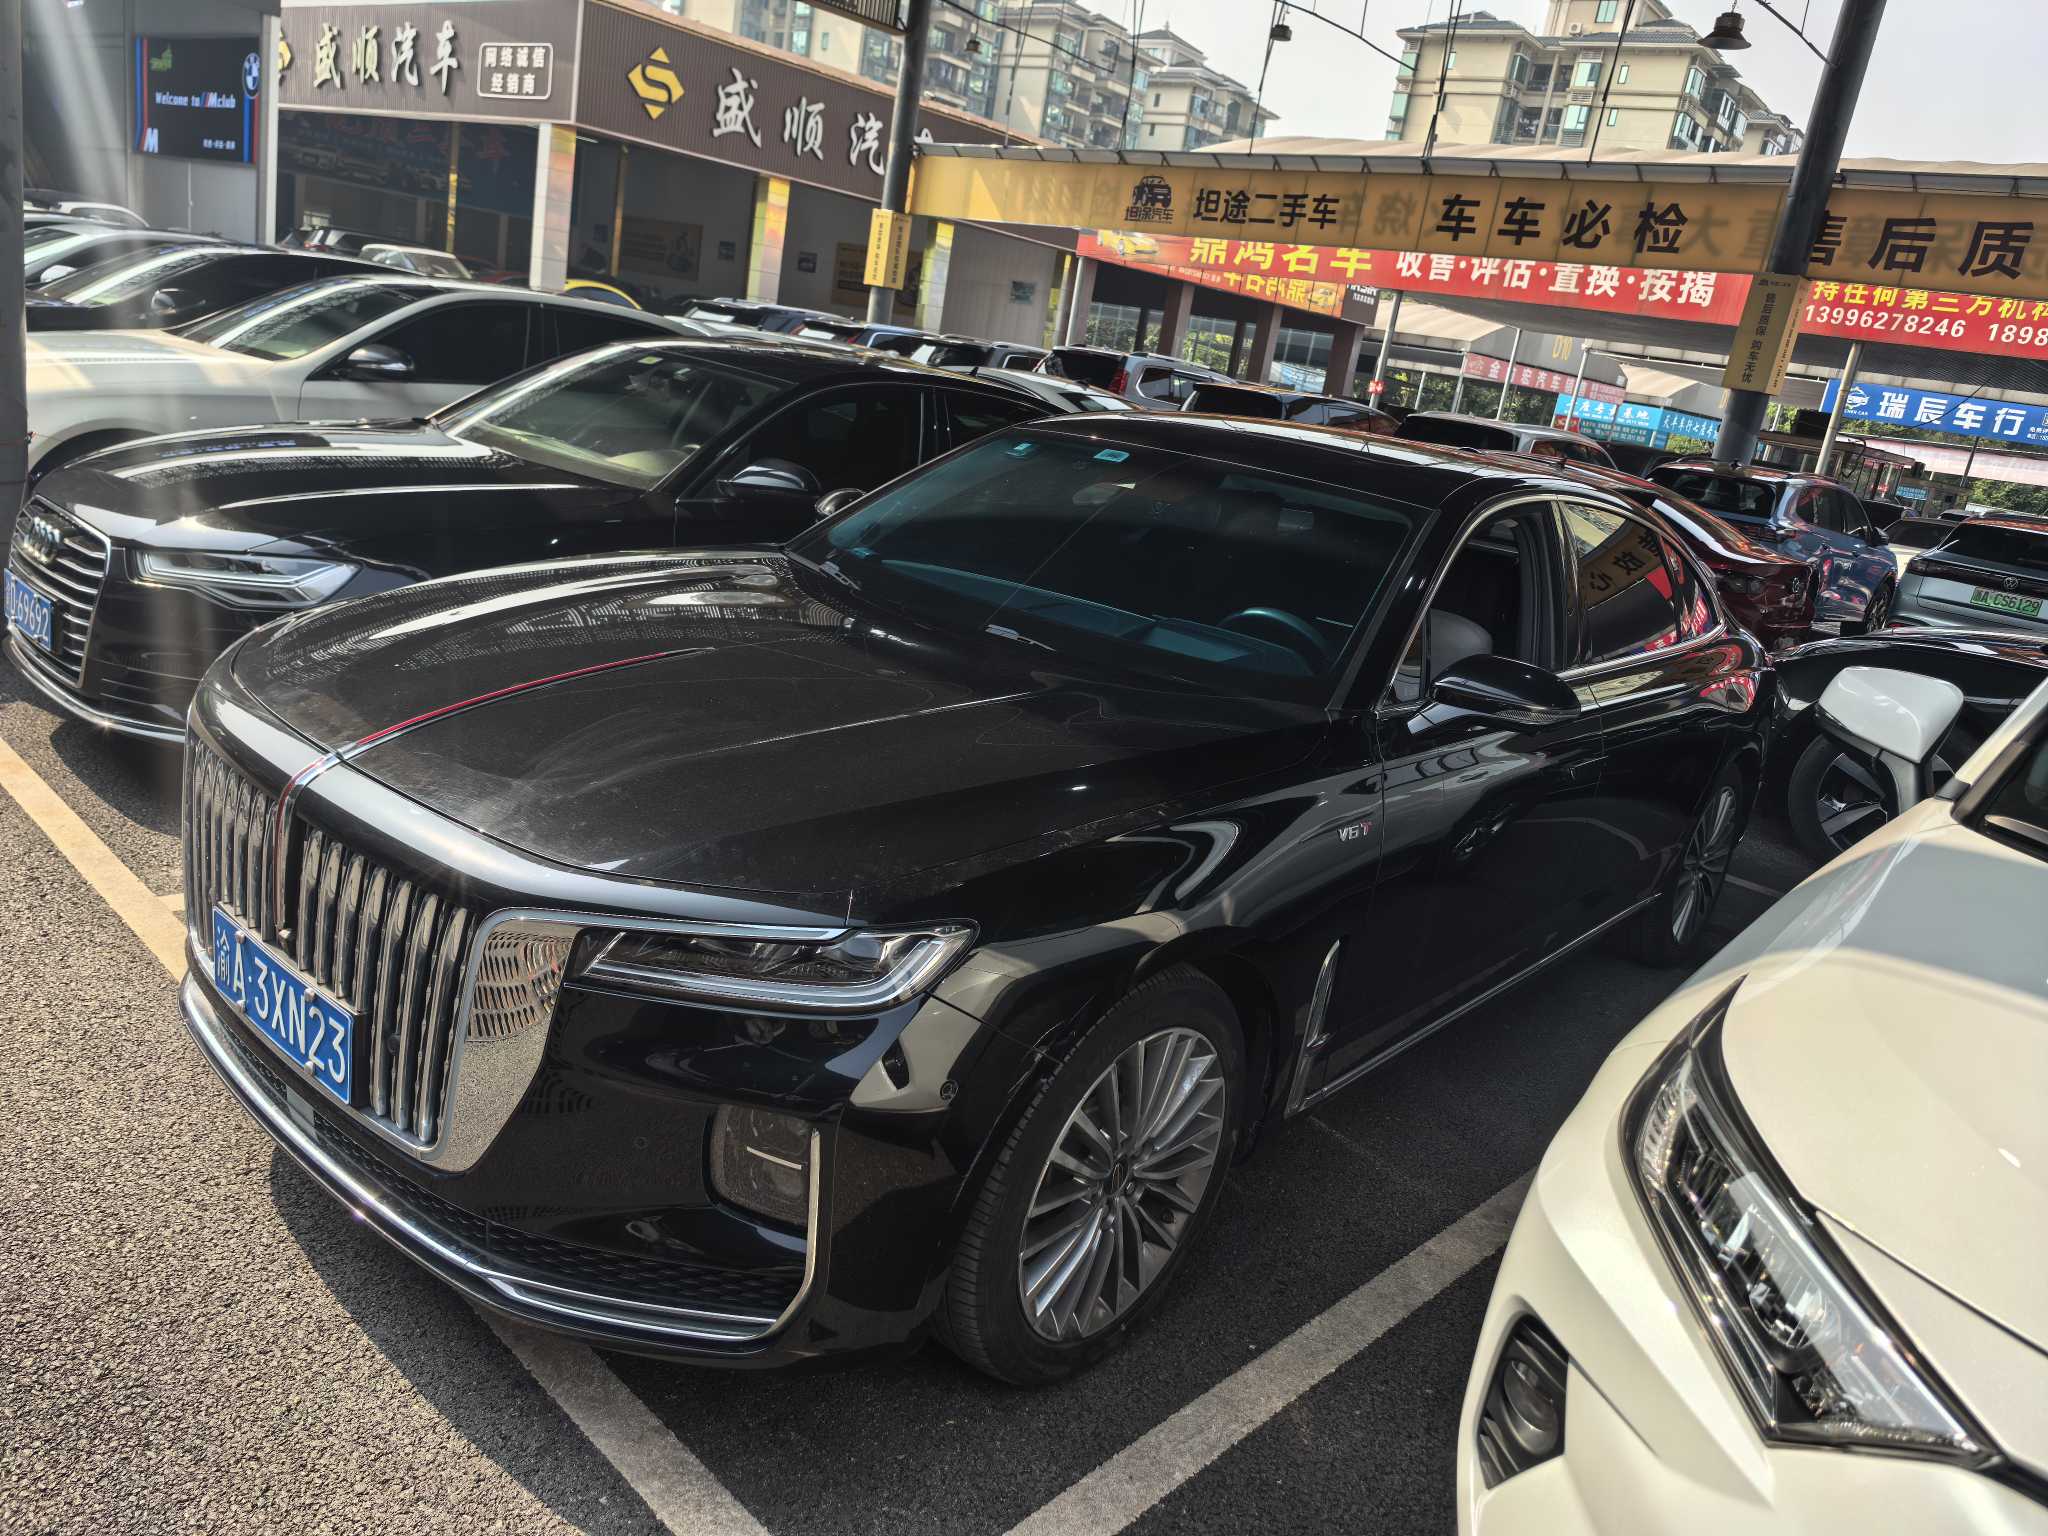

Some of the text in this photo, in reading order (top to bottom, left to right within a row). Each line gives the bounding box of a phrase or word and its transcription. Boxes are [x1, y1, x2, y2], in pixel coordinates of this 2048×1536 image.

[314, 20, 459, 96] 盛顺汽车
[155, 92, 189, 106] Welcome
[490, 73, 536, 94] 经销商
[1193, 187, 1341, 230] 坦途二手车
[1436, 193, 1688, 254] 车车必检
[1804, 304, 1967, 339] 13996278246
[1876, 391, 2027, 436] 瑞辰车行
